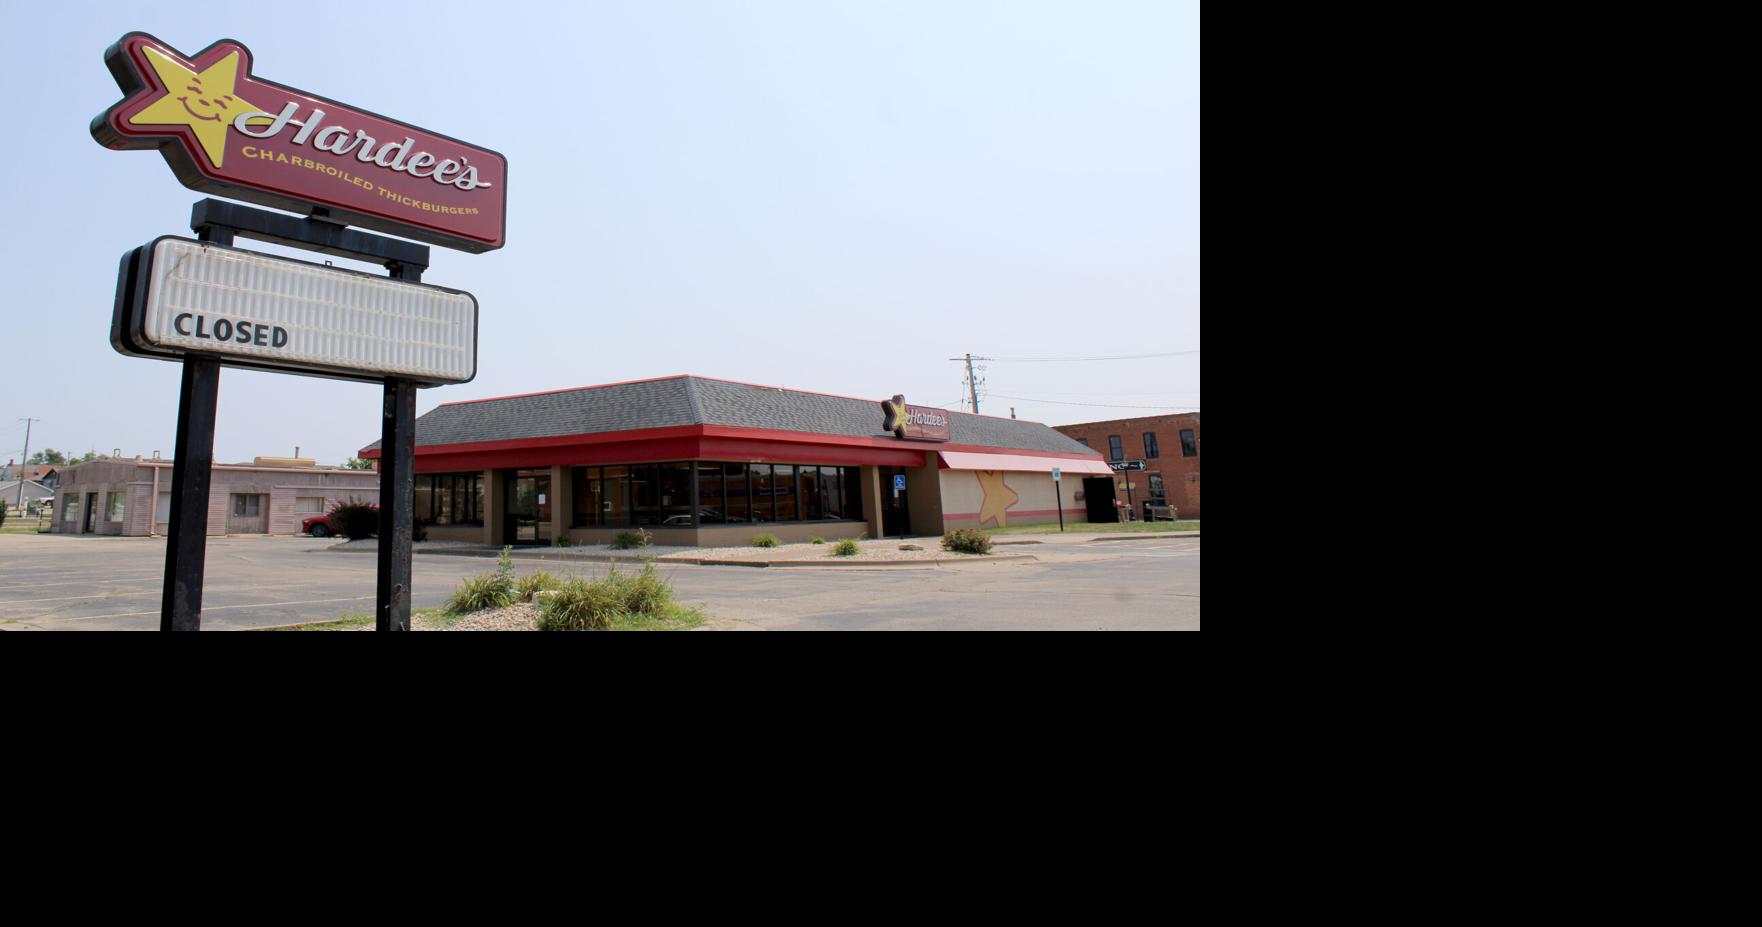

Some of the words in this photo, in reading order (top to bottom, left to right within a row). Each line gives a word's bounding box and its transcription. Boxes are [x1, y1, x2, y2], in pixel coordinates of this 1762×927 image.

[233, 101, 492, 191] Hardee's
[241, 146, 374, 190] CHARBROILED
[378, 187, 479, 215] THICKBURGERS
[174, 312, 288, 348] CLOSED
